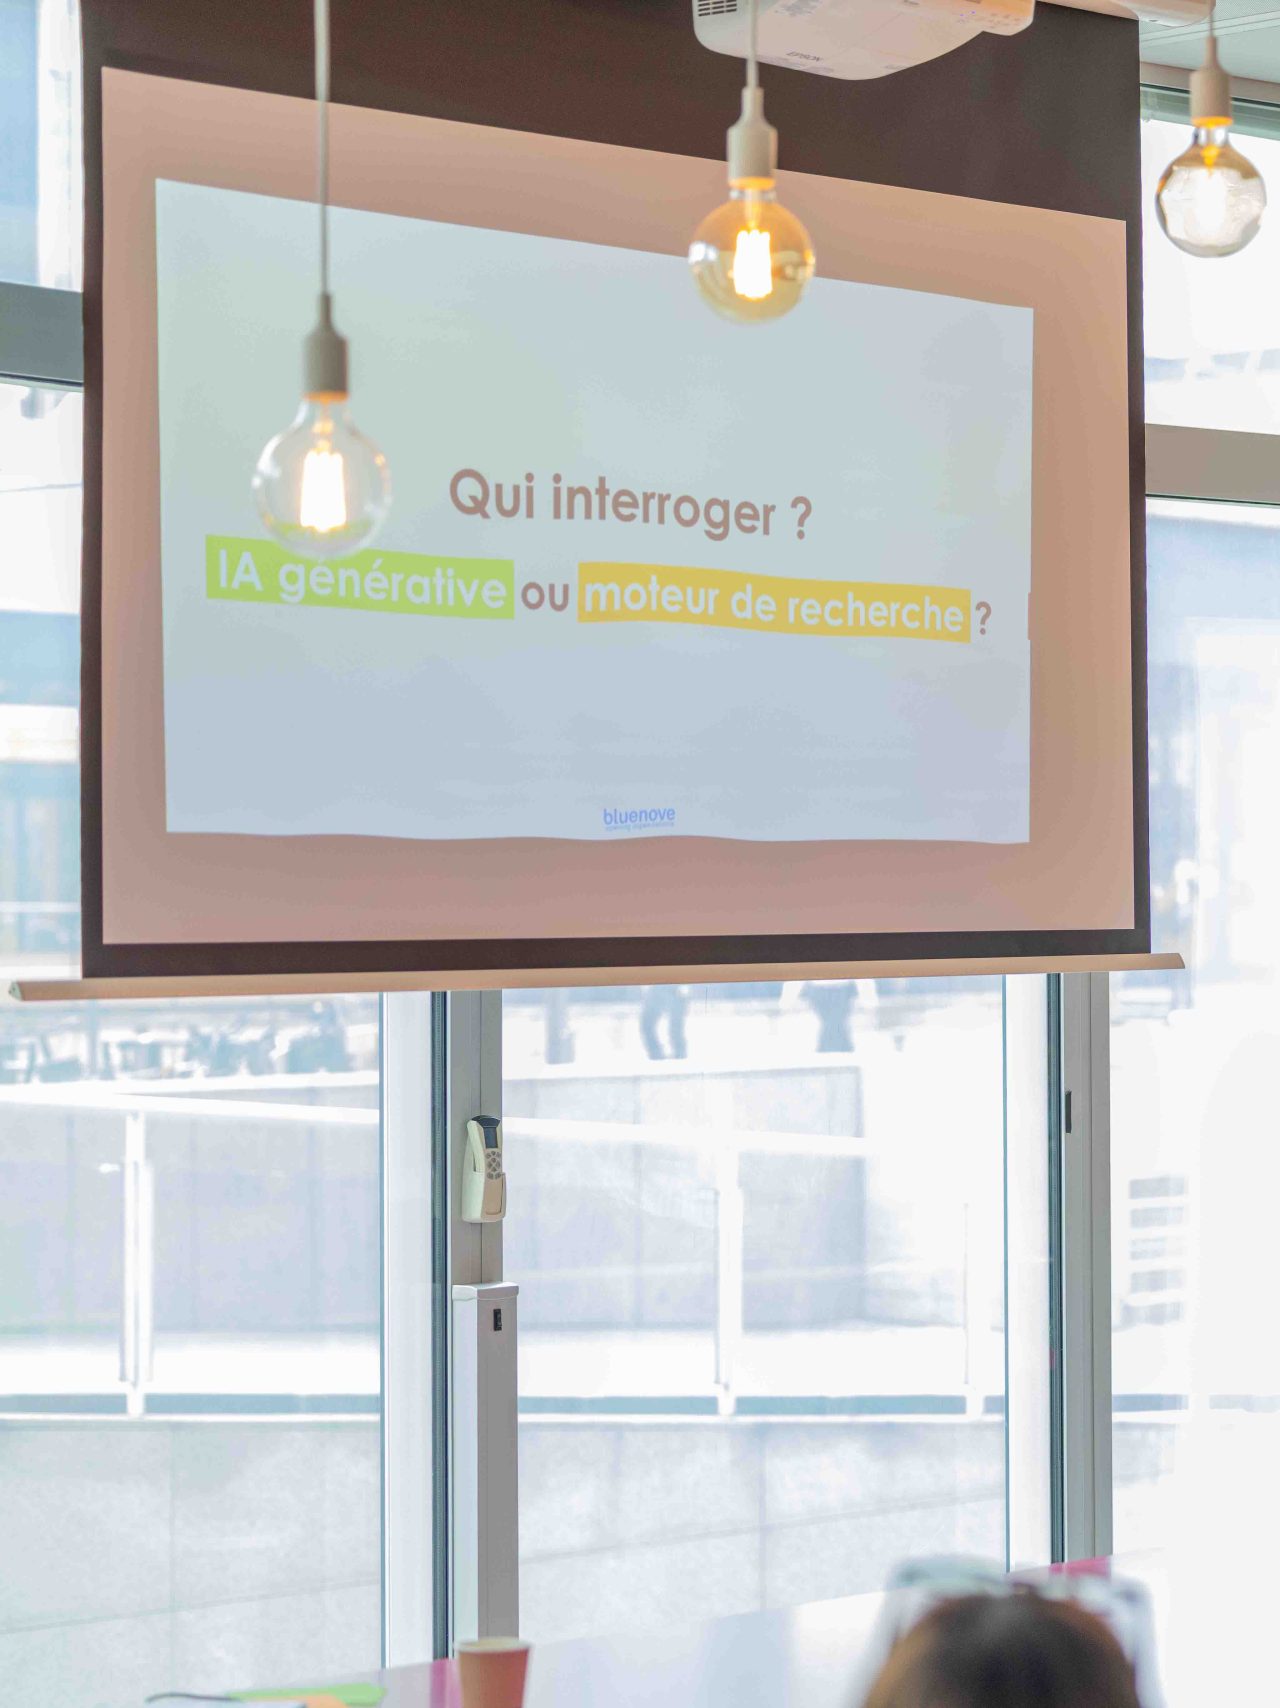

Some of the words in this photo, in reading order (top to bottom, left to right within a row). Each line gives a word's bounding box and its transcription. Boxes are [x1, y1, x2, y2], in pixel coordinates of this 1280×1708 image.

[449, 468, 535, 519] Qui
[552, 472, 776, 541] interroger
[790, 496, 812, 540] ?
[218, 548, 263, 591] IA
[278, 557, 507, 608] générative
[521, 582, 569, 612] ou
[584, 574, 719, 616] moteur
[731, 583, 777, 621] de
[788, 591, 964, 631] recherche
[975, 601, 992, 635] ?
[603, 807, 676, 825] bluenove
